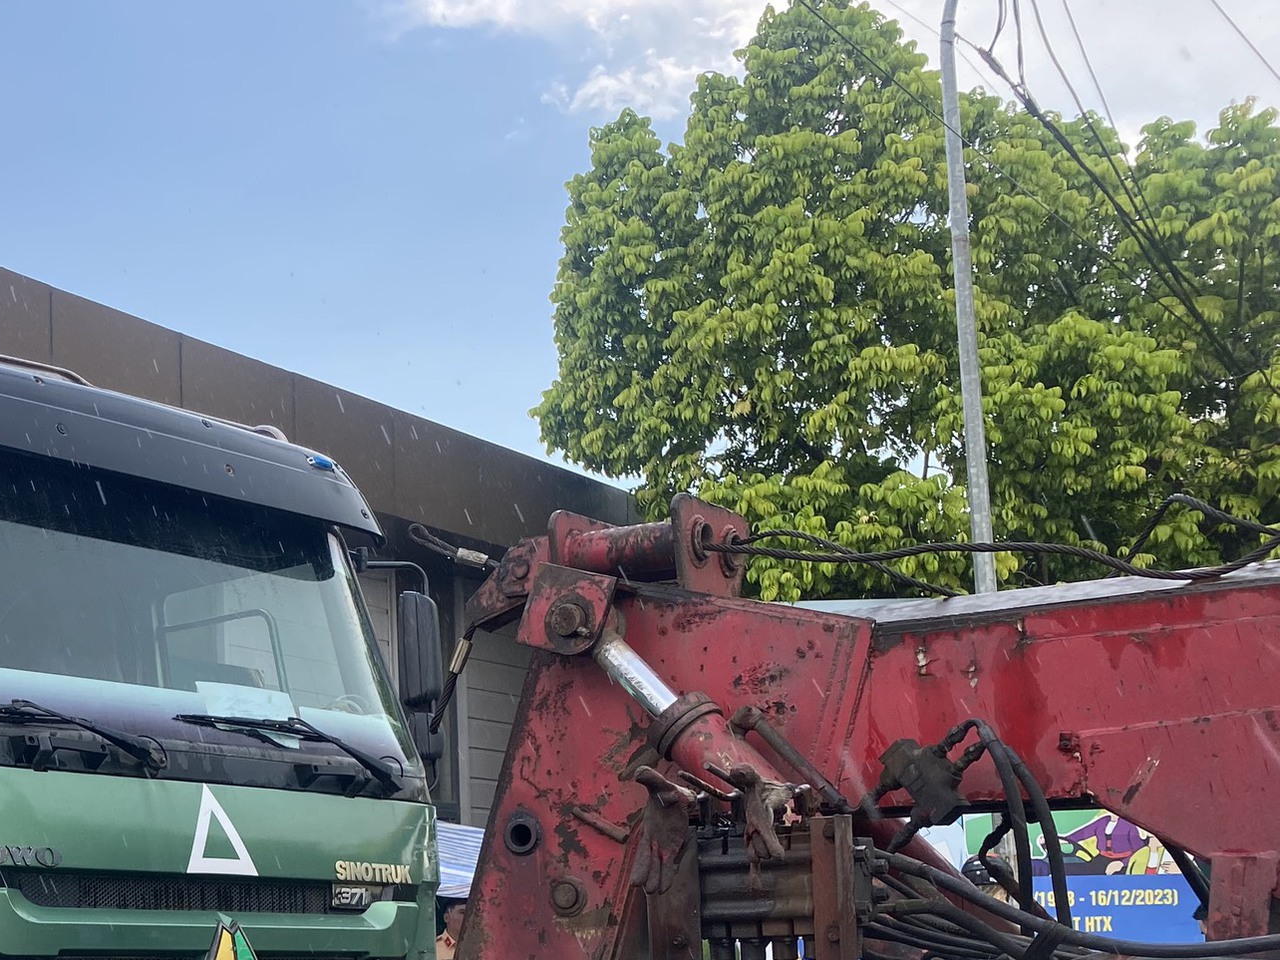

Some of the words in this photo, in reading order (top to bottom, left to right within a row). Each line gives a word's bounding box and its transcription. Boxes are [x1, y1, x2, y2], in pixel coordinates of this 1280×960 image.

[335, 860, 412, 884] SINOTRUK
[1089, 888, 1179, 906] 16/12/2023)
[1085, 916, 1113, 933] HTX
